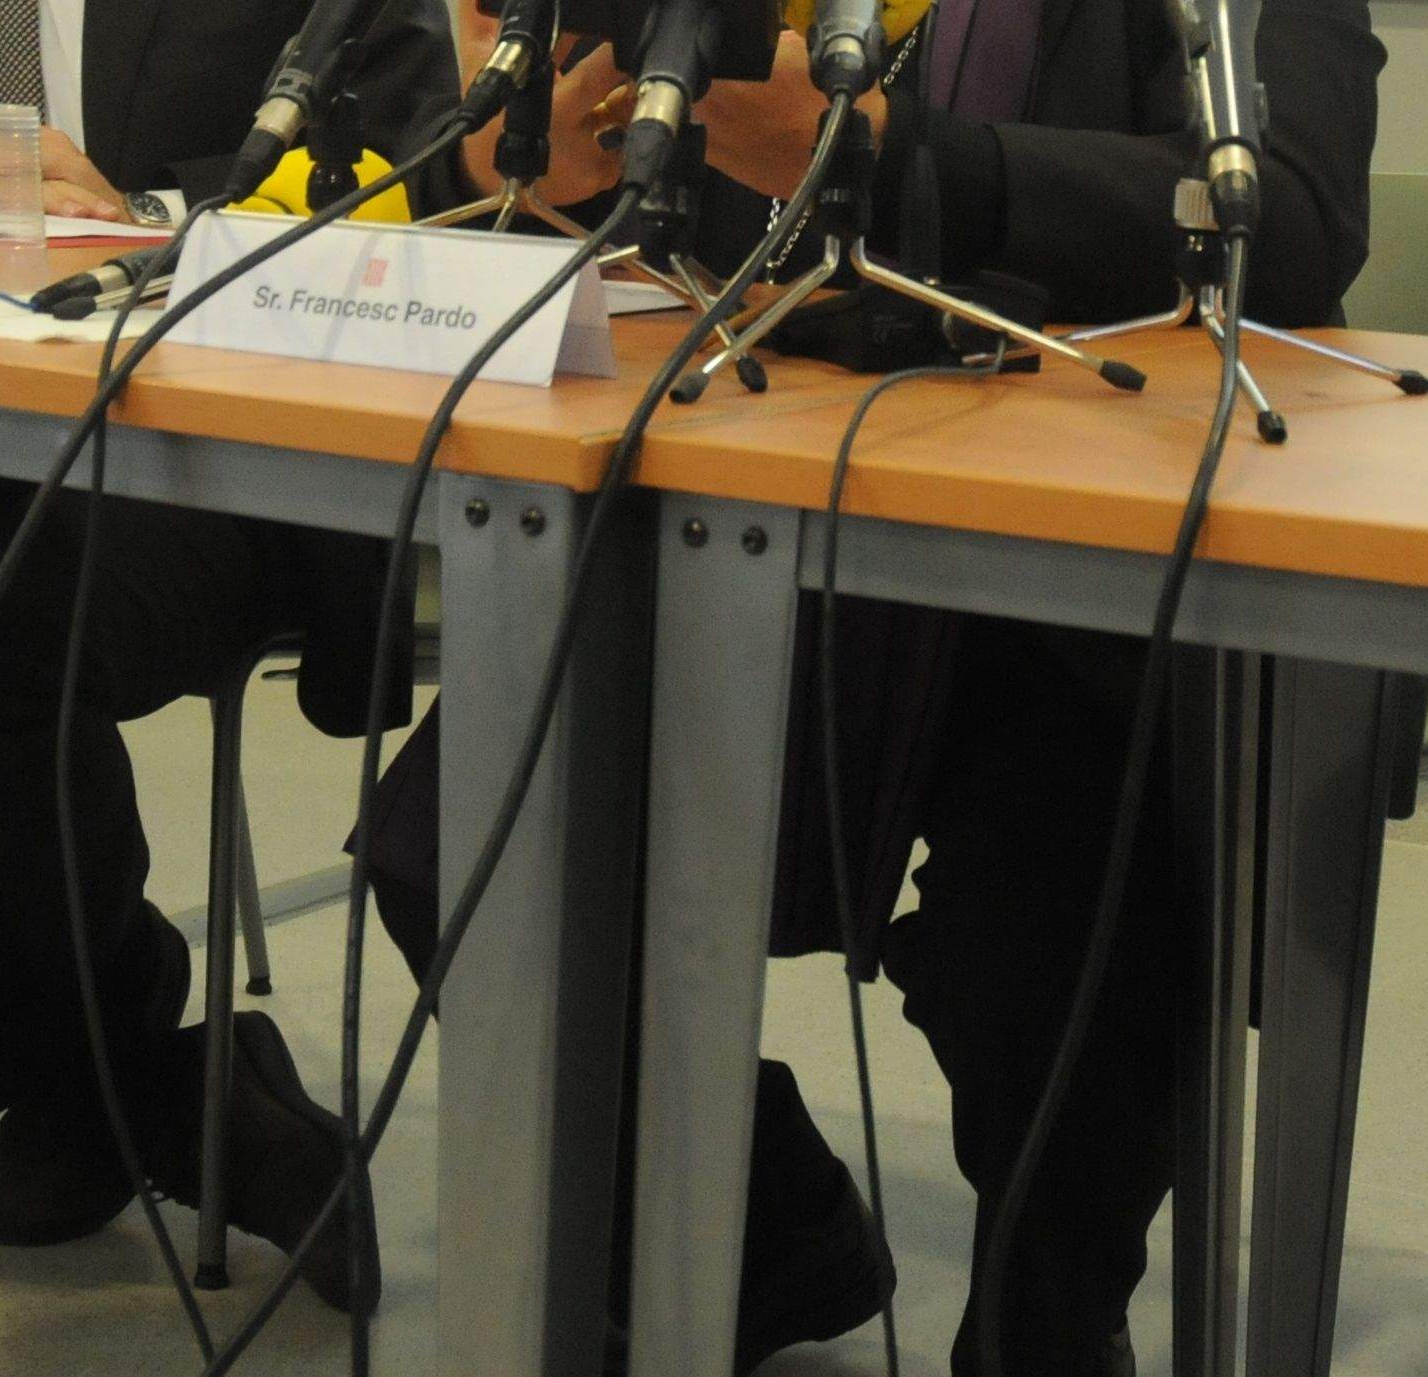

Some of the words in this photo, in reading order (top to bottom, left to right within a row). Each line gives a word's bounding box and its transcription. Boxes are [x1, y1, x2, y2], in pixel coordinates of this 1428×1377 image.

[253, 285, 282, 310] Sr.
[289, 290, 398, 323] Francesc
[403, 301, 476, 330] Pardo
